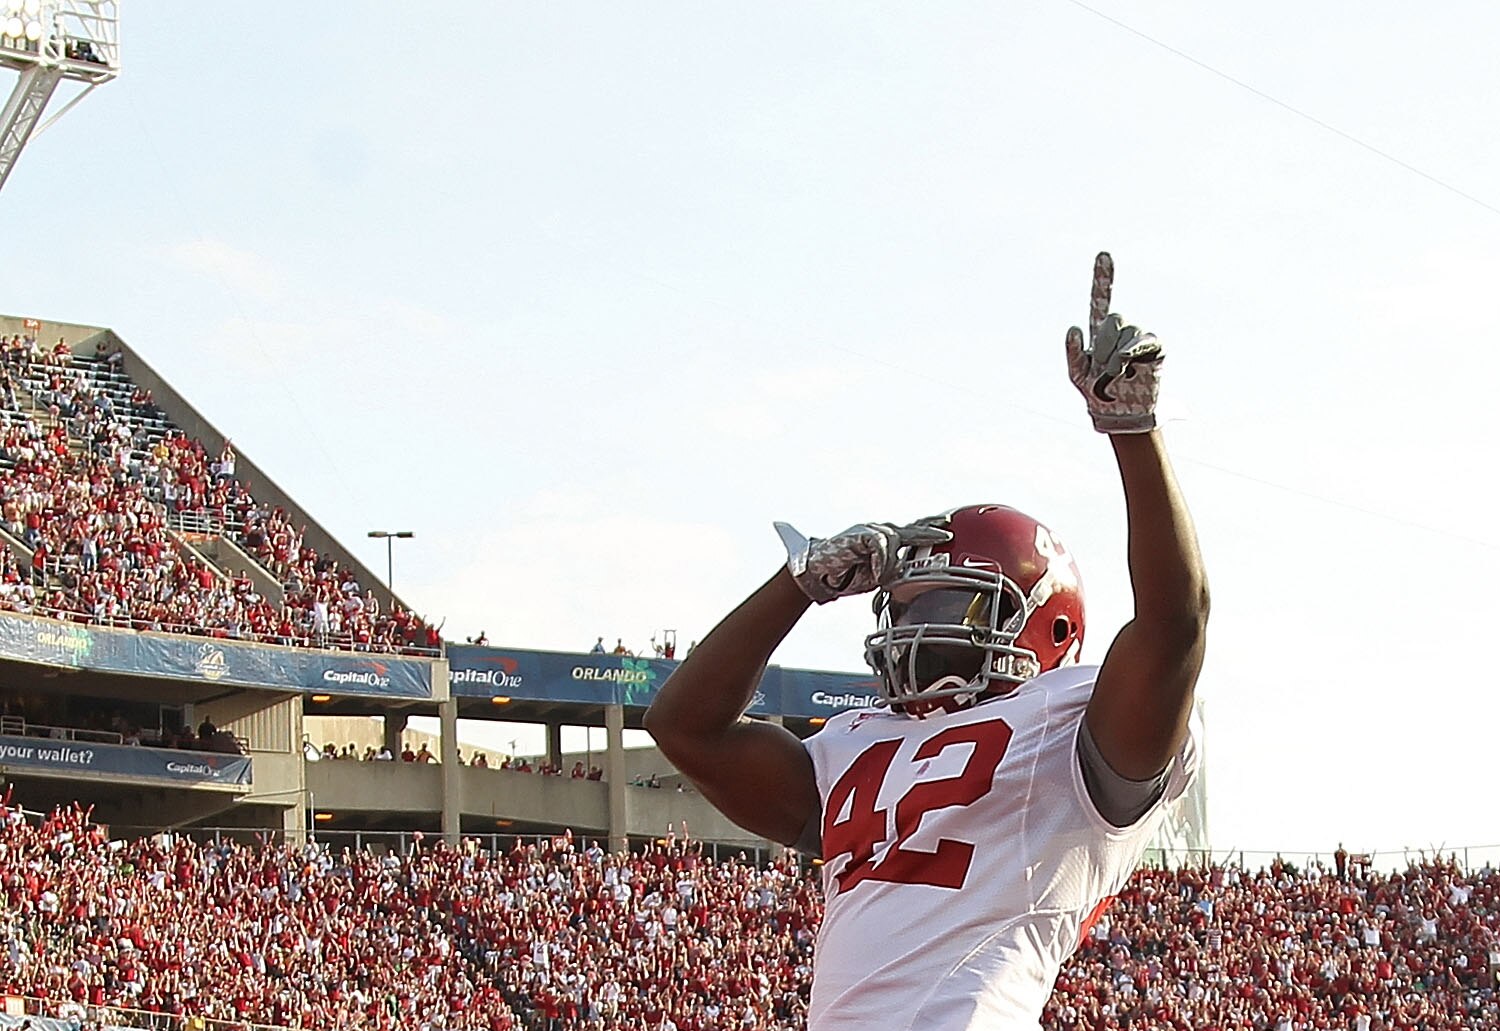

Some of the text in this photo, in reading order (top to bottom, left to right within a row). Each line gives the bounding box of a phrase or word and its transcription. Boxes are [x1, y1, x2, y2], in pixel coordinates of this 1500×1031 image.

[37, 632, 87, 649] ORLANDO
[572, 667, 647, 682] ORLANDO
[0, 746, 94, 765] your wallet?
[822, 717, 1014, 895] 42
